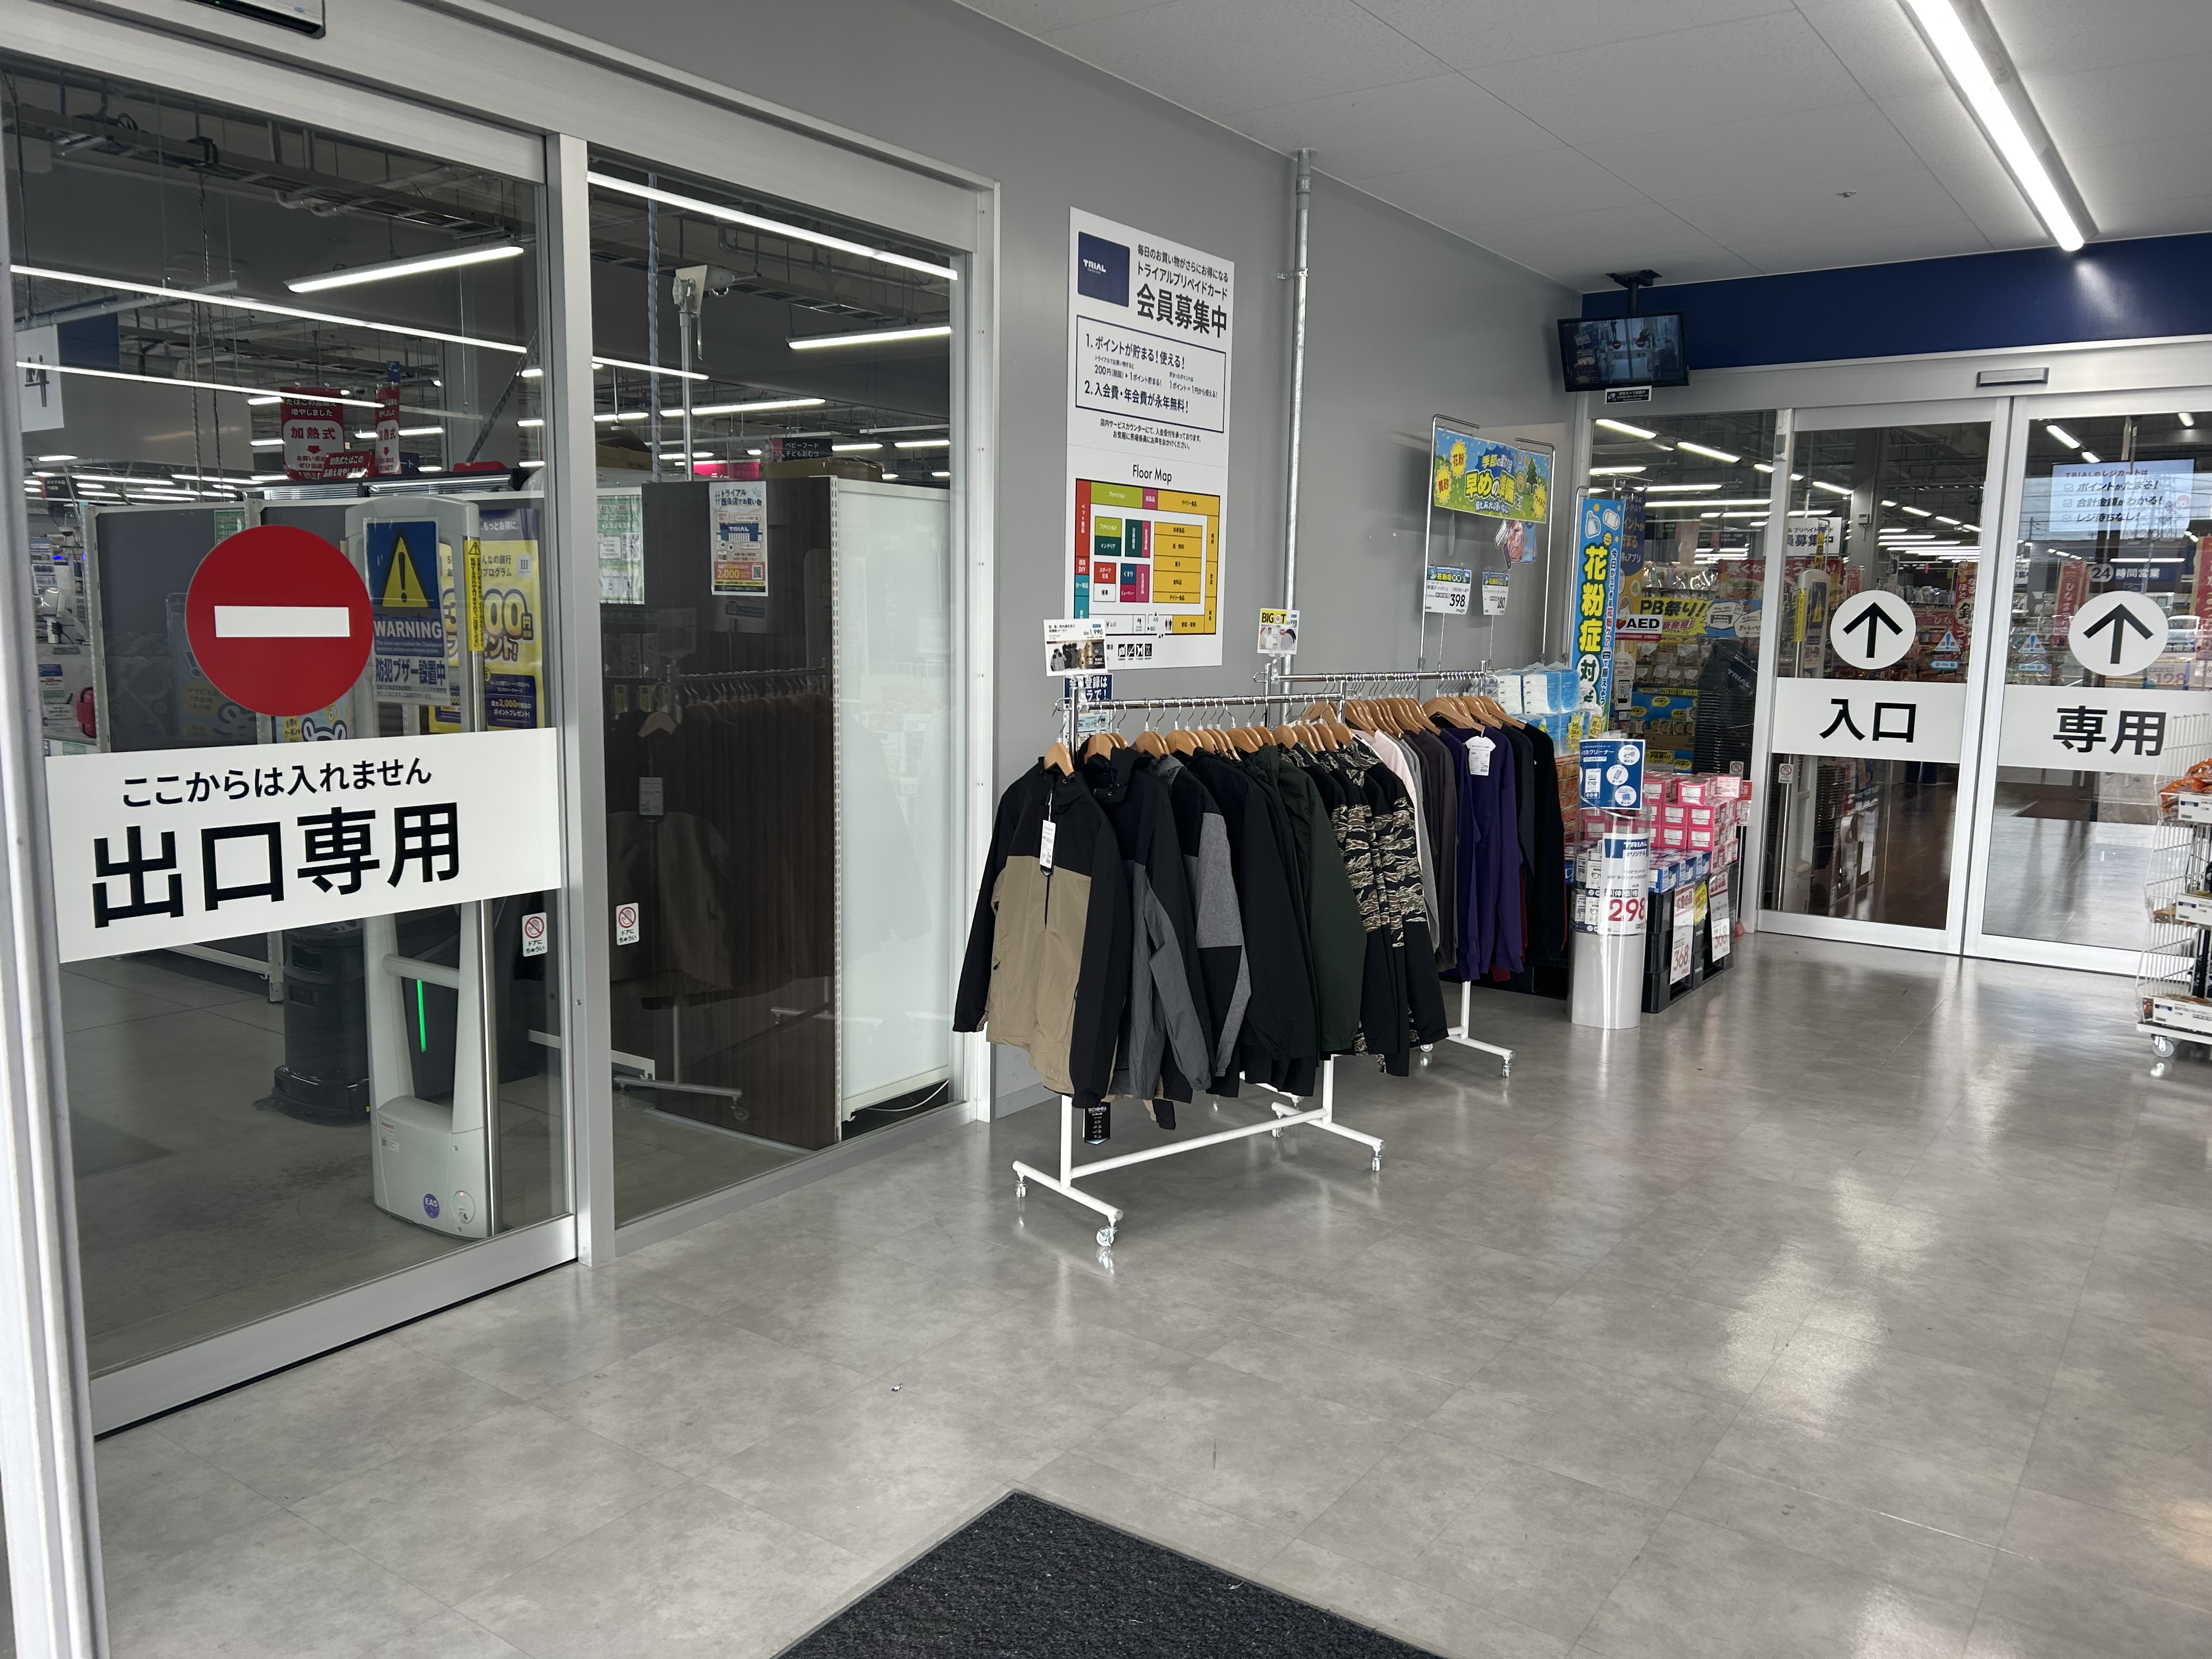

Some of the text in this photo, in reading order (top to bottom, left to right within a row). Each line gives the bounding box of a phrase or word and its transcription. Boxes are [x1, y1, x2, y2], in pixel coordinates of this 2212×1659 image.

[1083, 258, 1106, 273] TRIAL
[1138, 244, 1228, 283] 毎日のお買い物がさらにお得になる
[1138, 261, 1228, 301] トライアルプリペイドカード
[1137, 283, 1227, 338] 会員募集中
[291, 408, 333, 417] 増やしました
[291, 426, 336, 439] 加熱式
[1453, 454, 1464, 467] 花粉
[1133, 464, 1172, 486] Floor Map
[1438, 477, 1449, 493] 黄砂
[481, 555, 511, 565] んなの銀行
[1727, 561, 1765, 575] 寒くな
[481, 568, 512, 577] プログラム
[2092, 567, 2111, 579] 24
[1449, 594, 1465, 607] 398
[1640, 600, 1706, 617] PB祭り!
[1262, 612, 1274, 623] BIG
[1626, 618, 1660, 629] AED
[374, 620, 442, 639] WARNING
[375, 658, 445, 685] 防犯ブザー設置中
[1728, 669, 1751, 688] TRIAL
[2155, 673, 2186, 685] 128
[1069, 676, 1108, 689] 会登録は
[1819, 698, 1917, 743] 入口
[2053, 706, 2167, 757] 専用
[123, 758, 432, 808] ここからは入れません
[92, 802, 460, 928] 出口専用
[1608, 897, 1646, 922] 298
[1673, 944, 1689, 971] 368
[425, 1197, 438, 1207] EAS
